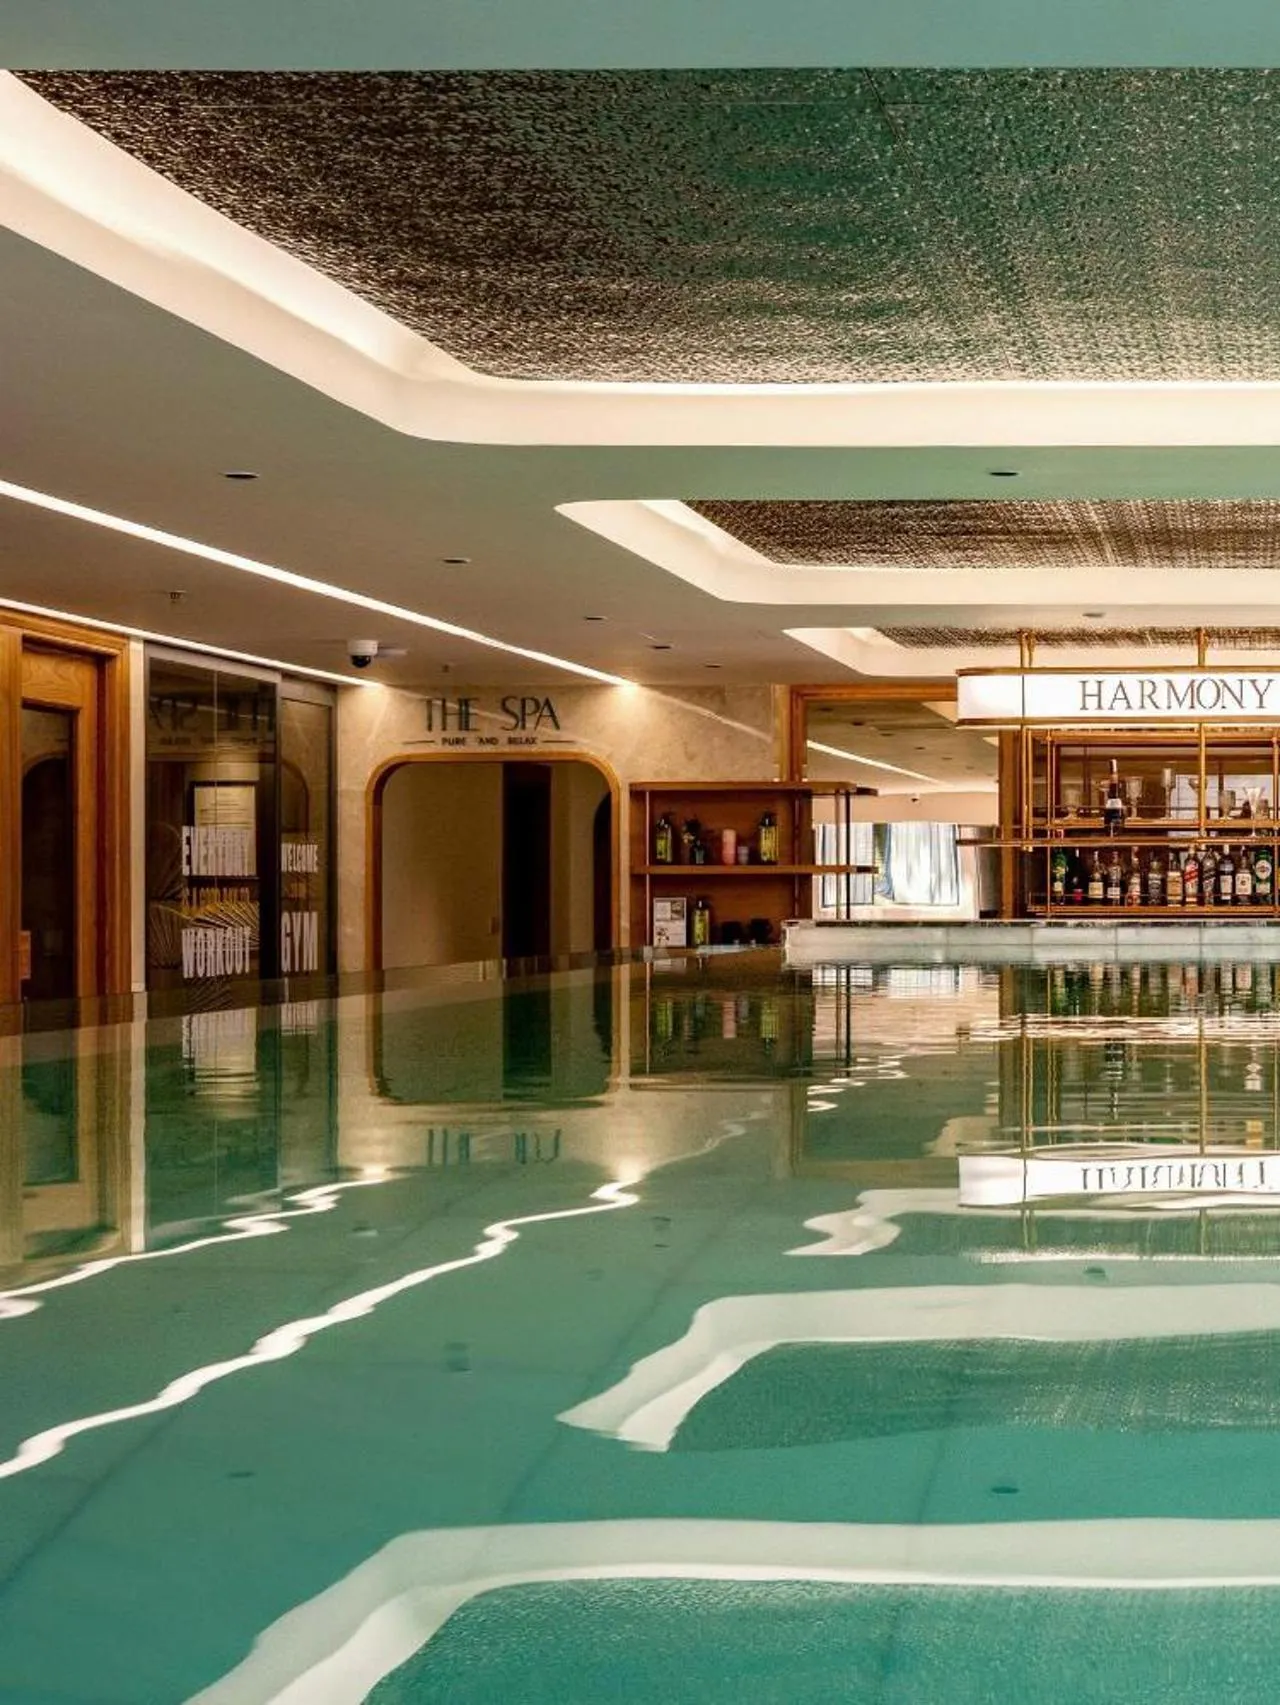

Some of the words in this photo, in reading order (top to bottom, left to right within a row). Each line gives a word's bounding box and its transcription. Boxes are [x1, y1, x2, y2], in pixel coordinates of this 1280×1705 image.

[1079, 677, 1275, 711] HARMONY
[418, 697, 481, 732] THE
[501, 696, 561, 731] SPA
[478, 736, 499, 746] AND
[281, 842, 318, 873] WELCOME
[182, 926, 251, 979] WORKOUT
[281, 911, 318, 972] GYM
